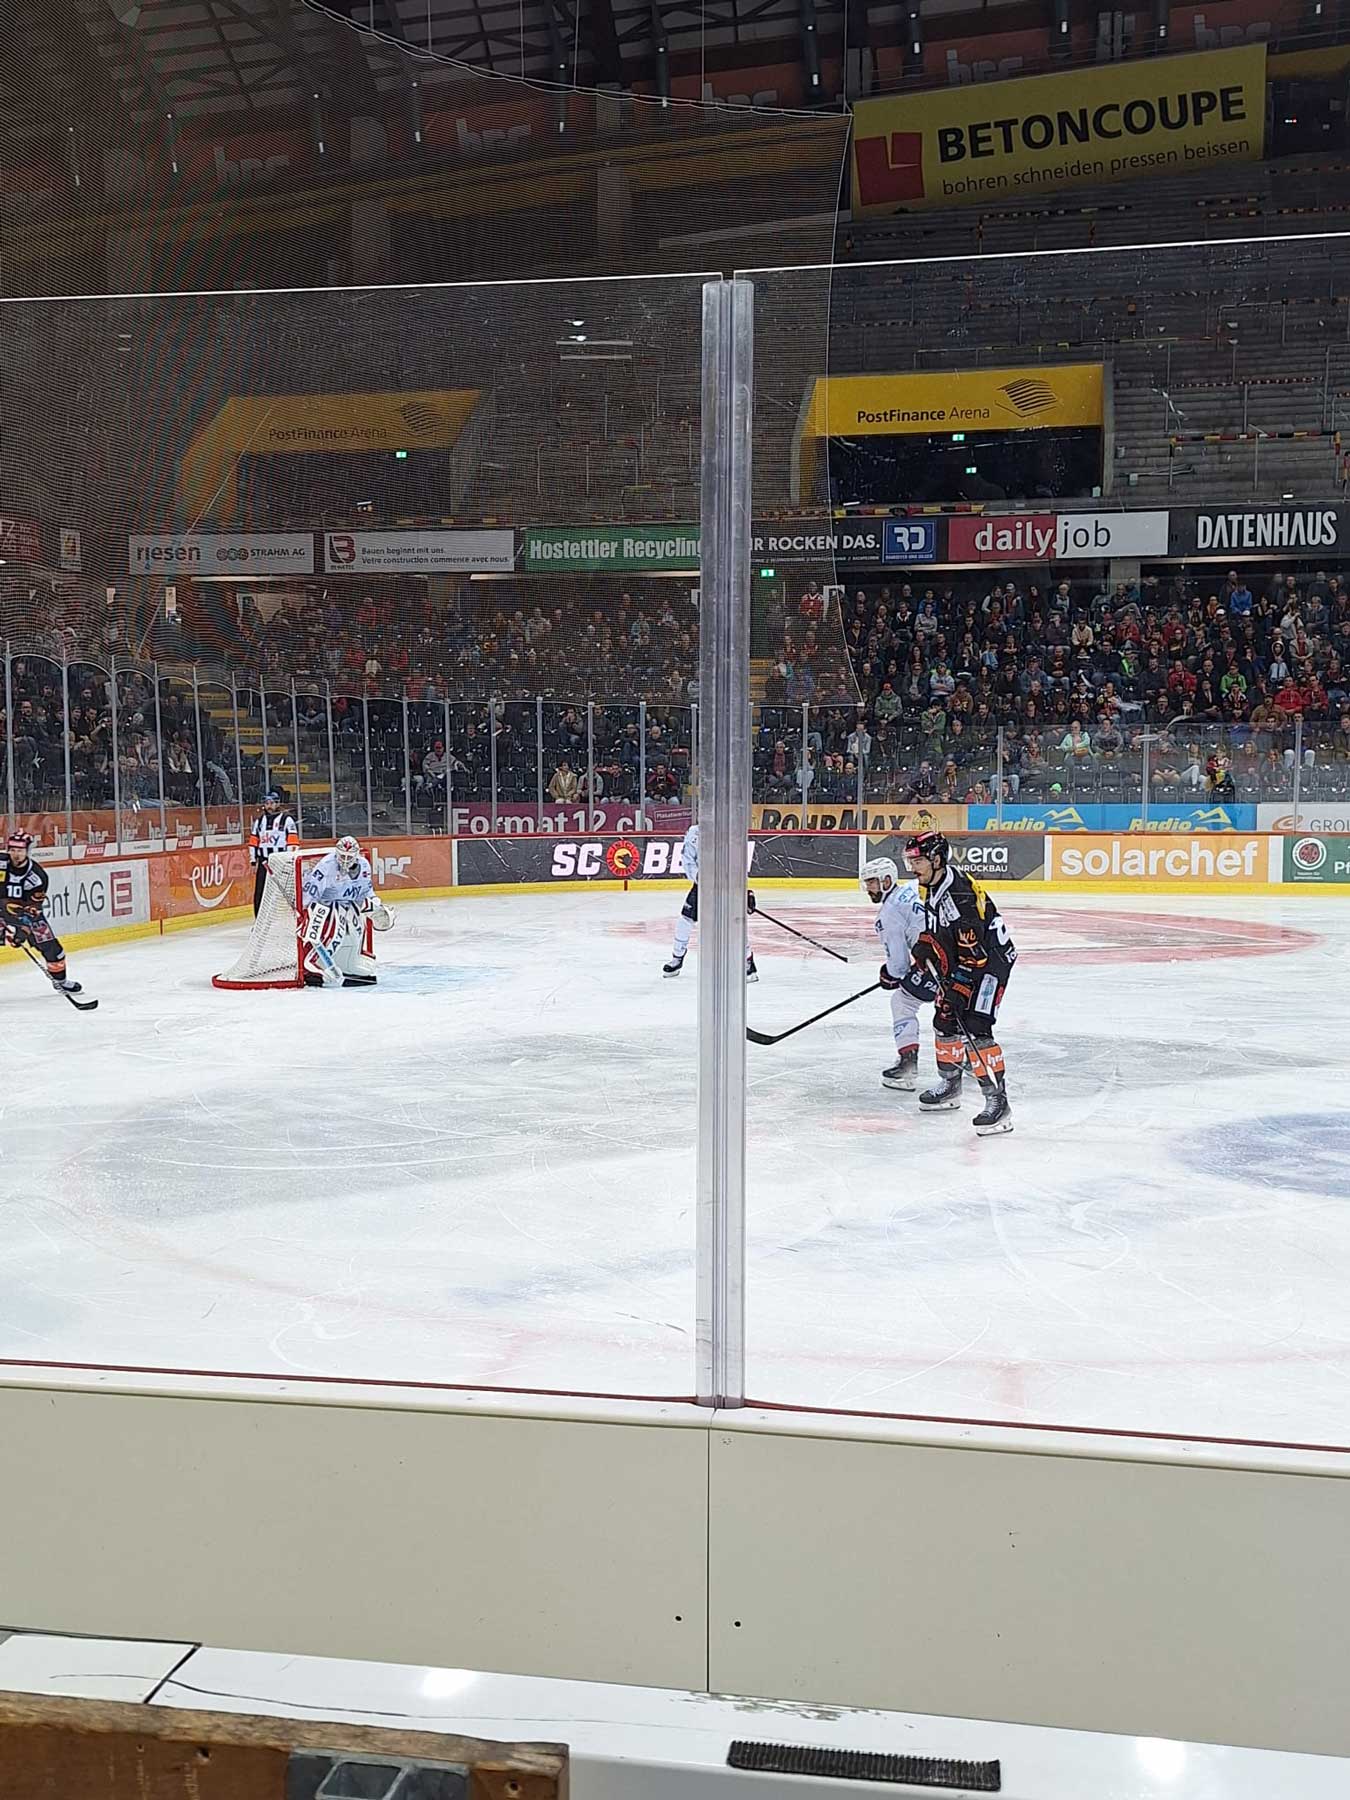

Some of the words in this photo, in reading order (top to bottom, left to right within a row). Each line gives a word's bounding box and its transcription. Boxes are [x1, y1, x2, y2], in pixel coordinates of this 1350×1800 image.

[938, 86, 1246, 163] BETONCOUPE
[942, 175, 1008, 195] bohren
[1013, 159, 1104, 185] schneiden
[1110, 149, 1178, 174] pressen
[1183, 138, 1250, 160] beissen
[857, 408, 945, 423] PostFinance
[949, 406, 990, 420] Arena
[269, 427, 347, 440] PostFinance
[1197, 511, 1338, 549] DATENHAUS
[530, 539, 618, 560] Hostettler
[769, 535, 838, 550] ROCKEN
[843, 534, 881, 549] DAS.
[383, 556, 428, 564] construction
[985, 818, 1046, 831] Radio
[1129, 818, 1192, 831] Radio
[1310, 819, 1350, 832] GRO
[260, 832, 280, 846] sky
[551, 843, 603, 876] SC
[1061, 840, 1259, 877] solarchef
[189, 855, 224, 888] ewb
[956, 863, 1008, 872] NRÜCKBAU
[6, 885, 22, 898] 10
[76, 880, 105, 917] AG
[309, 907, 326, 940] DATIS
